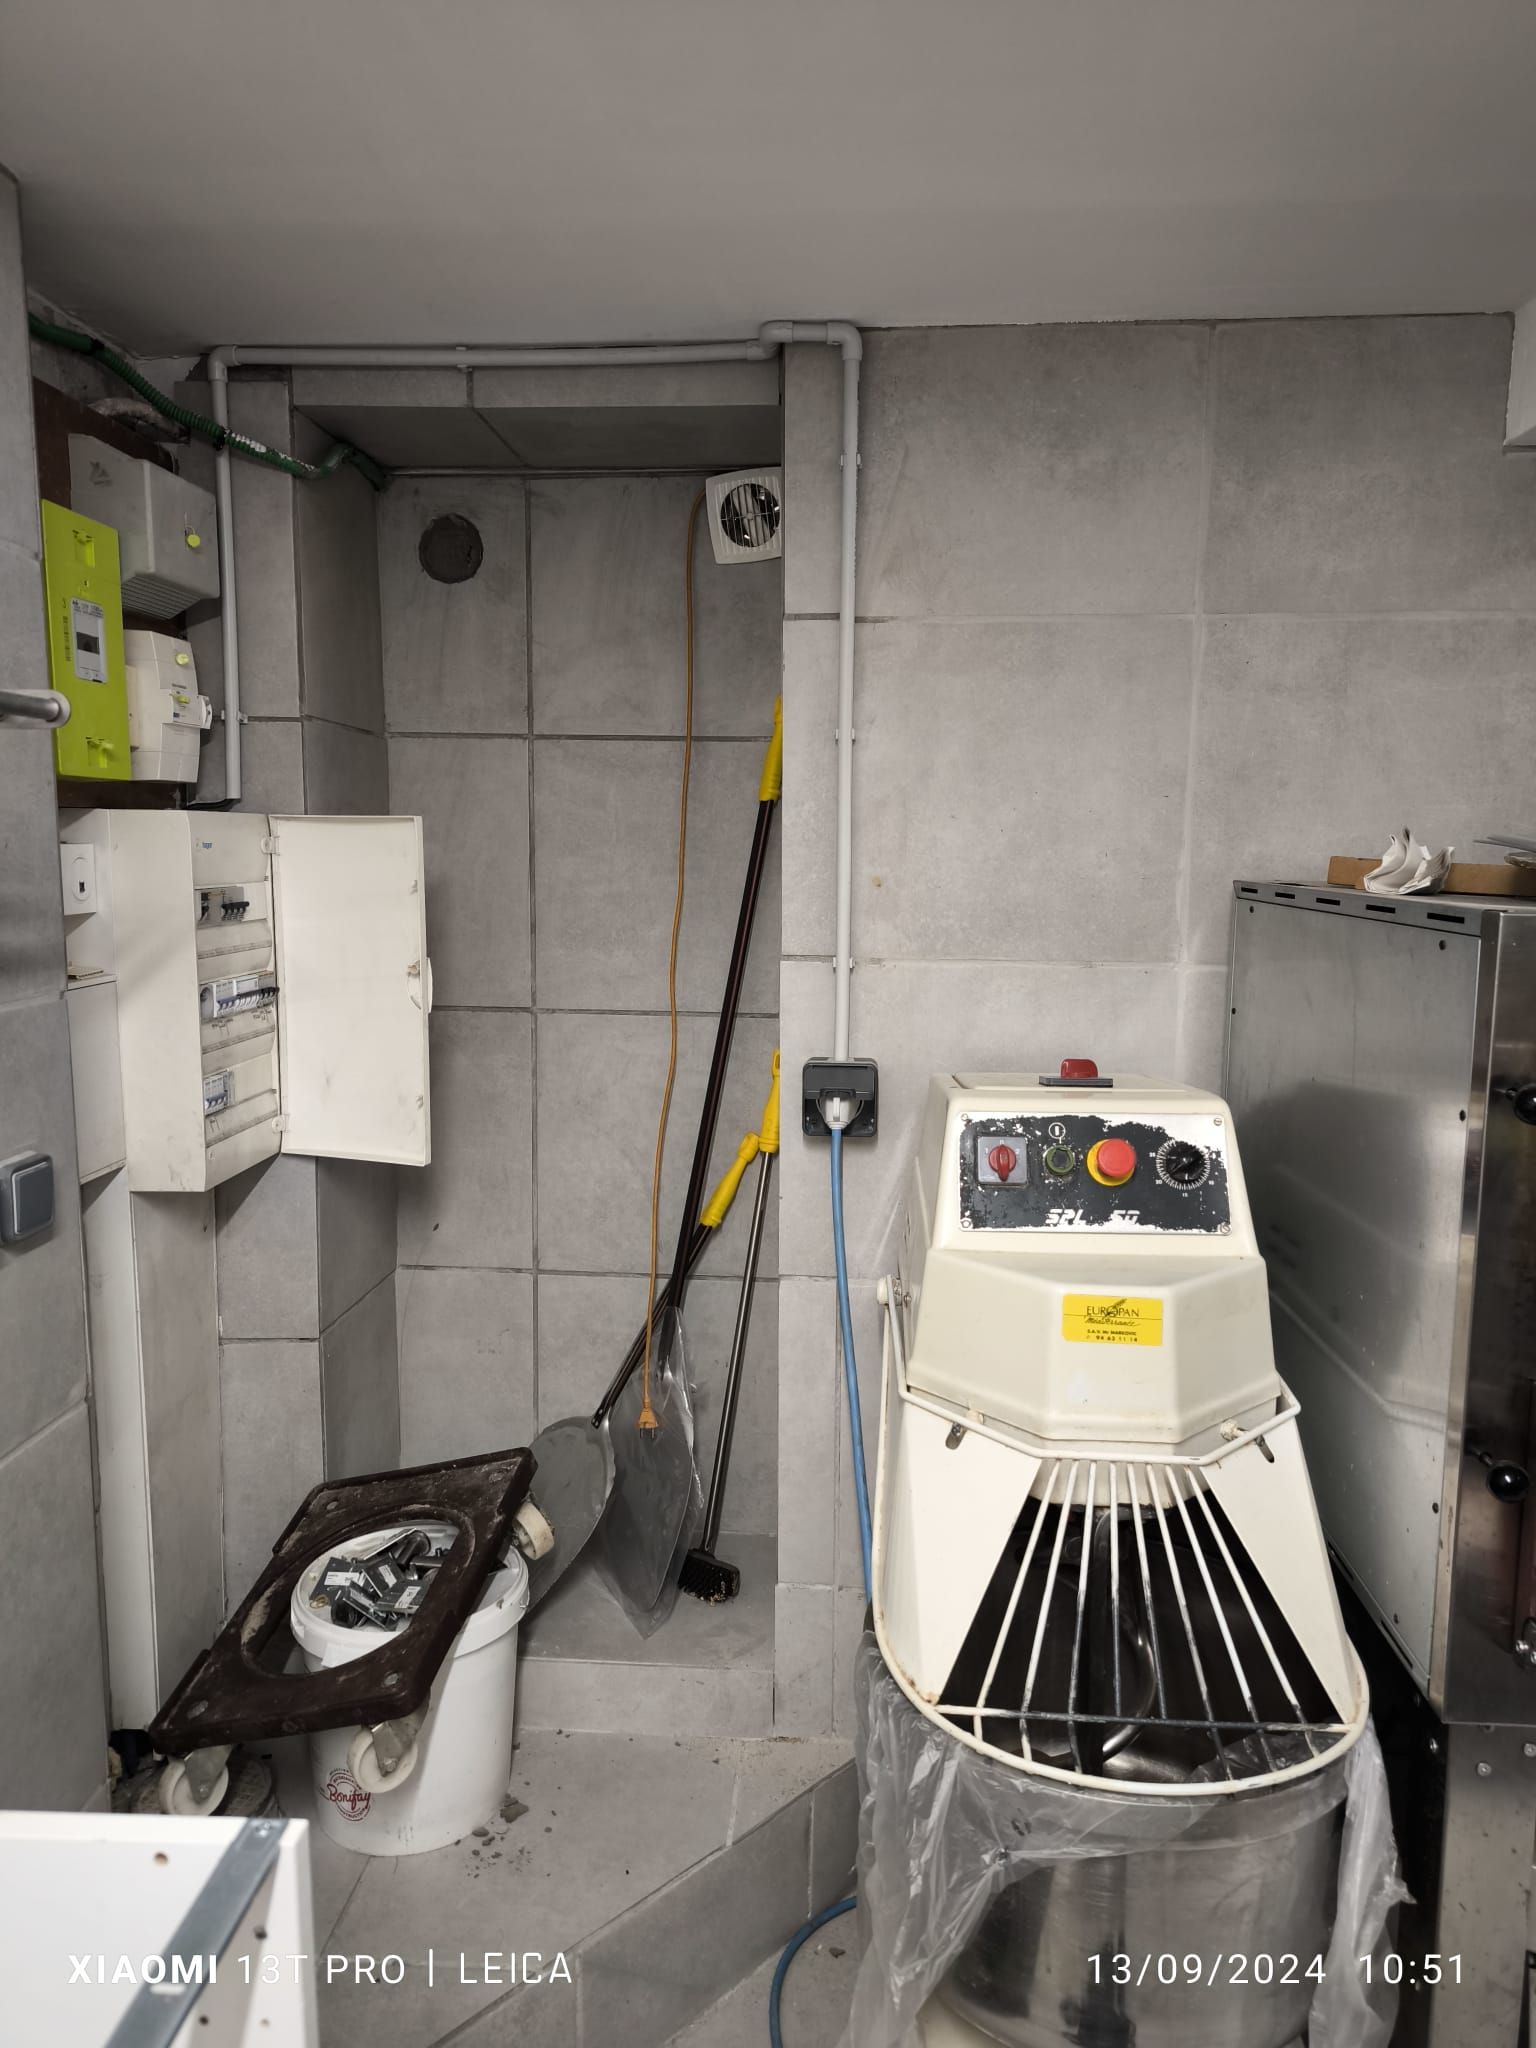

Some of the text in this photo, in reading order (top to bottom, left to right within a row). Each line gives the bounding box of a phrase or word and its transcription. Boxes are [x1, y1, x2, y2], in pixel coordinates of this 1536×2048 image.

[1045, 1208, 1087, 1225] SPL
[1086, 1305, 1139, 1317] EUROPAN
[327, 1783, 371, 1811] Bonifay
